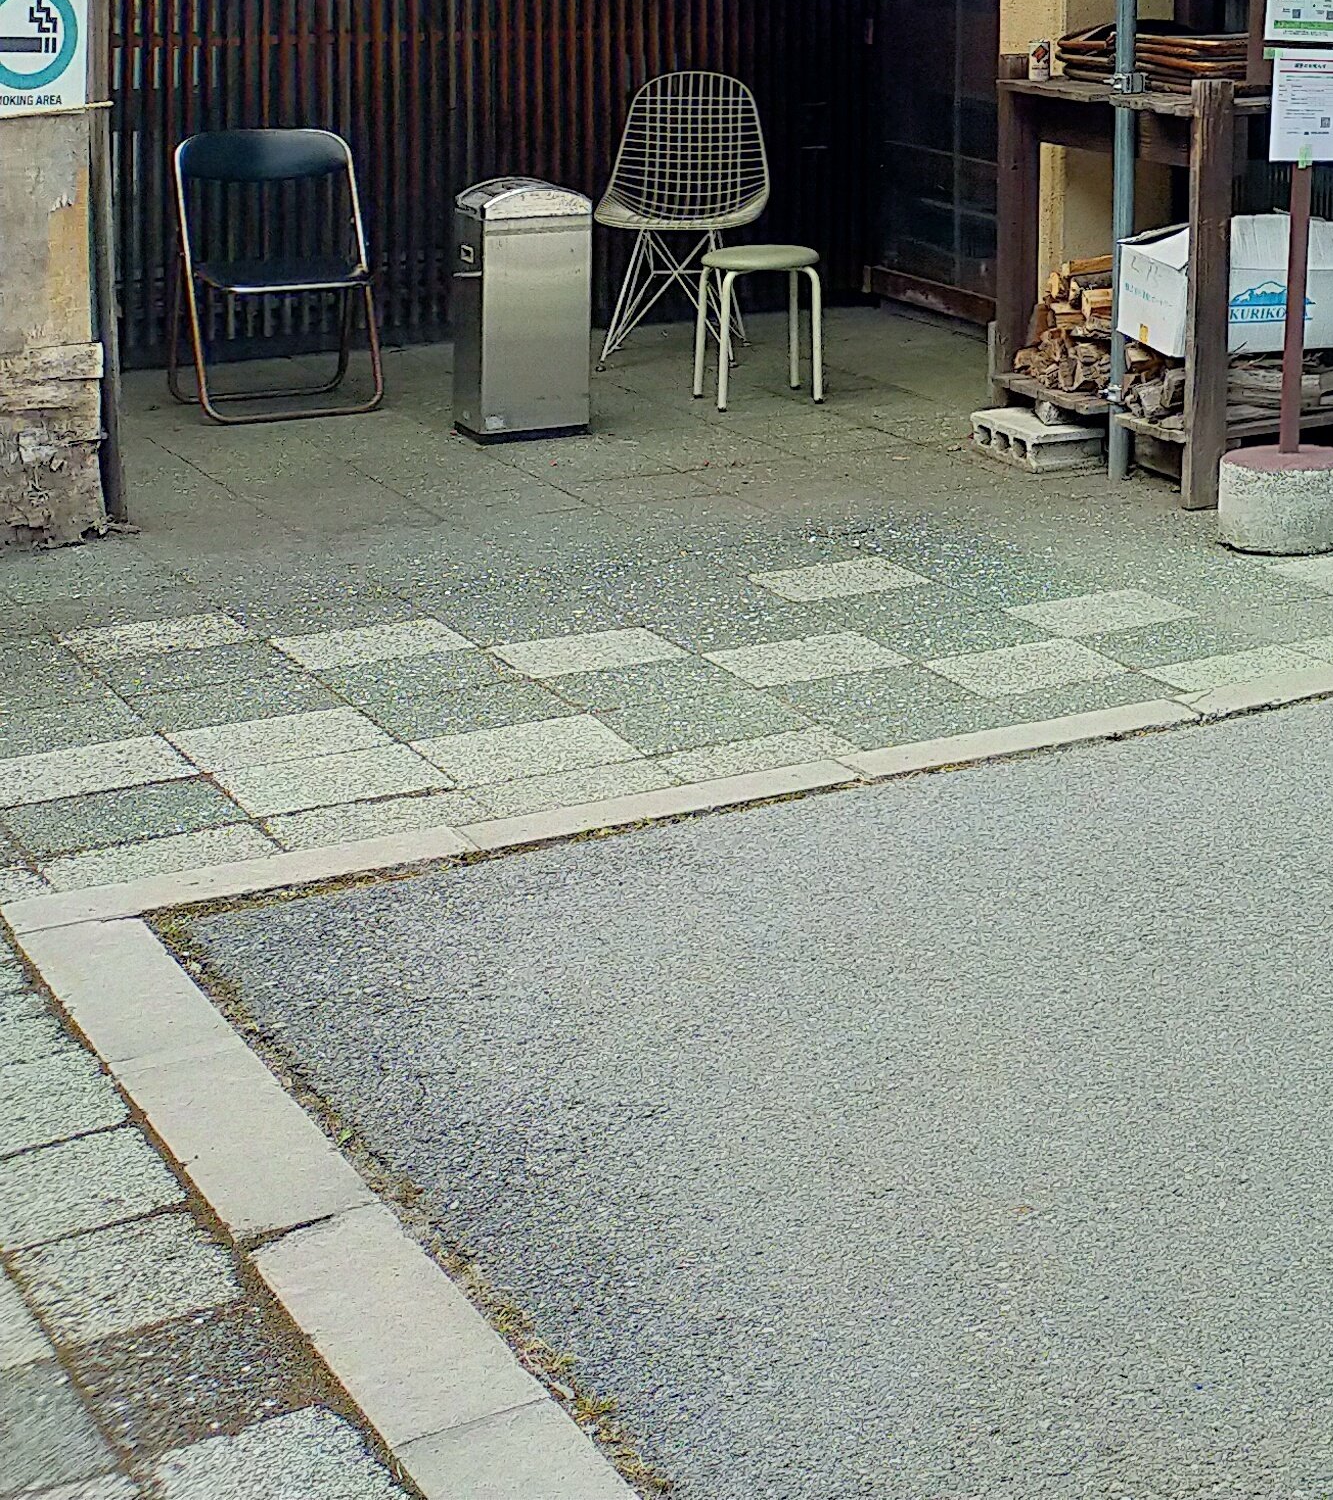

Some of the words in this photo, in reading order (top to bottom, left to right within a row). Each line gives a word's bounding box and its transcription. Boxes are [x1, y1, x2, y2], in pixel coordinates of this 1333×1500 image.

[0, 95, 33, 106] OKING
[35, 94, 62, 105] AREA
[1229, 306, 1308, 321] KURIKO
